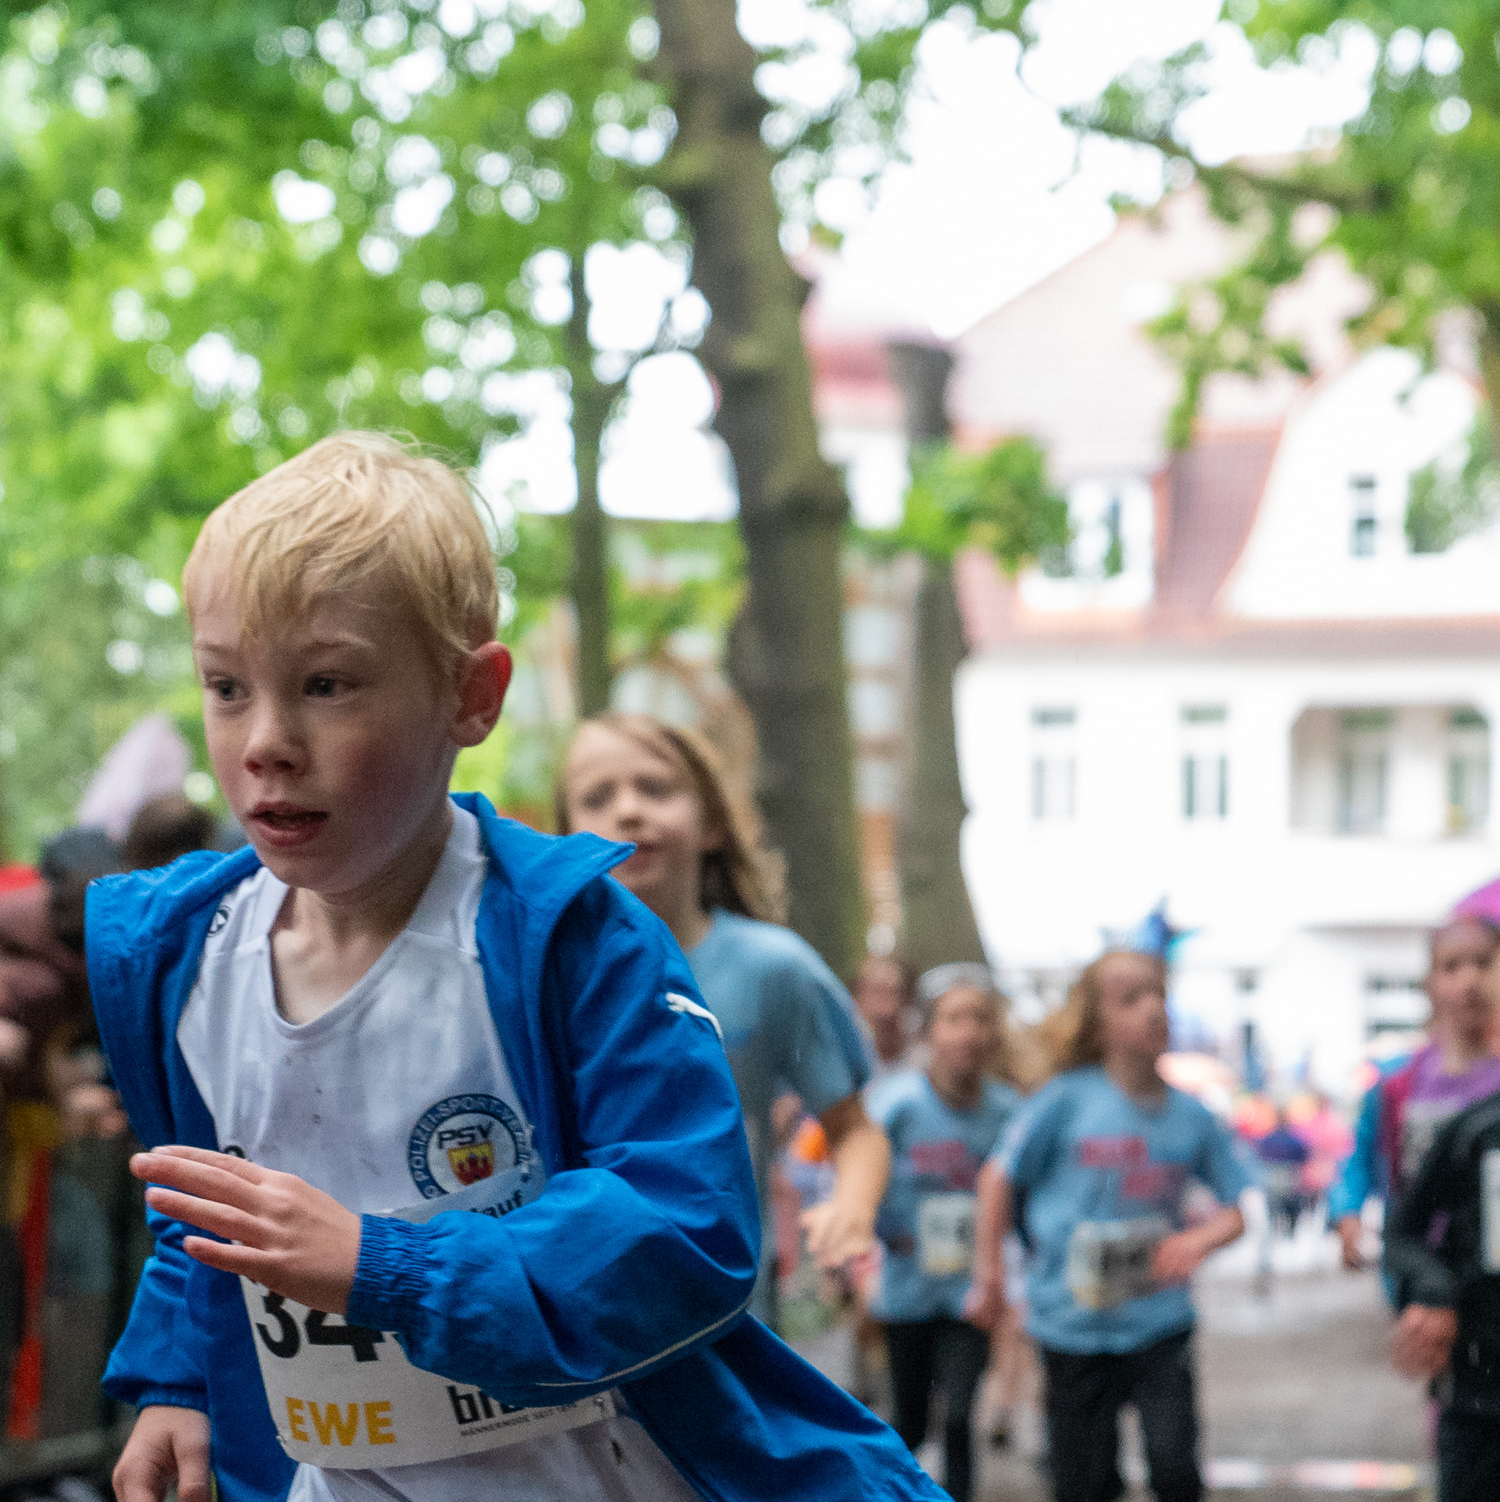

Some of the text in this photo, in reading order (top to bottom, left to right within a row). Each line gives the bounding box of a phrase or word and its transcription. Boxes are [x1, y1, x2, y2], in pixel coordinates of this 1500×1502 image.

[438, 1120, 495, 1149] PSV
[256, 1291, 387, 1363] 34
[285, 1396, 397, 1447] EWE
